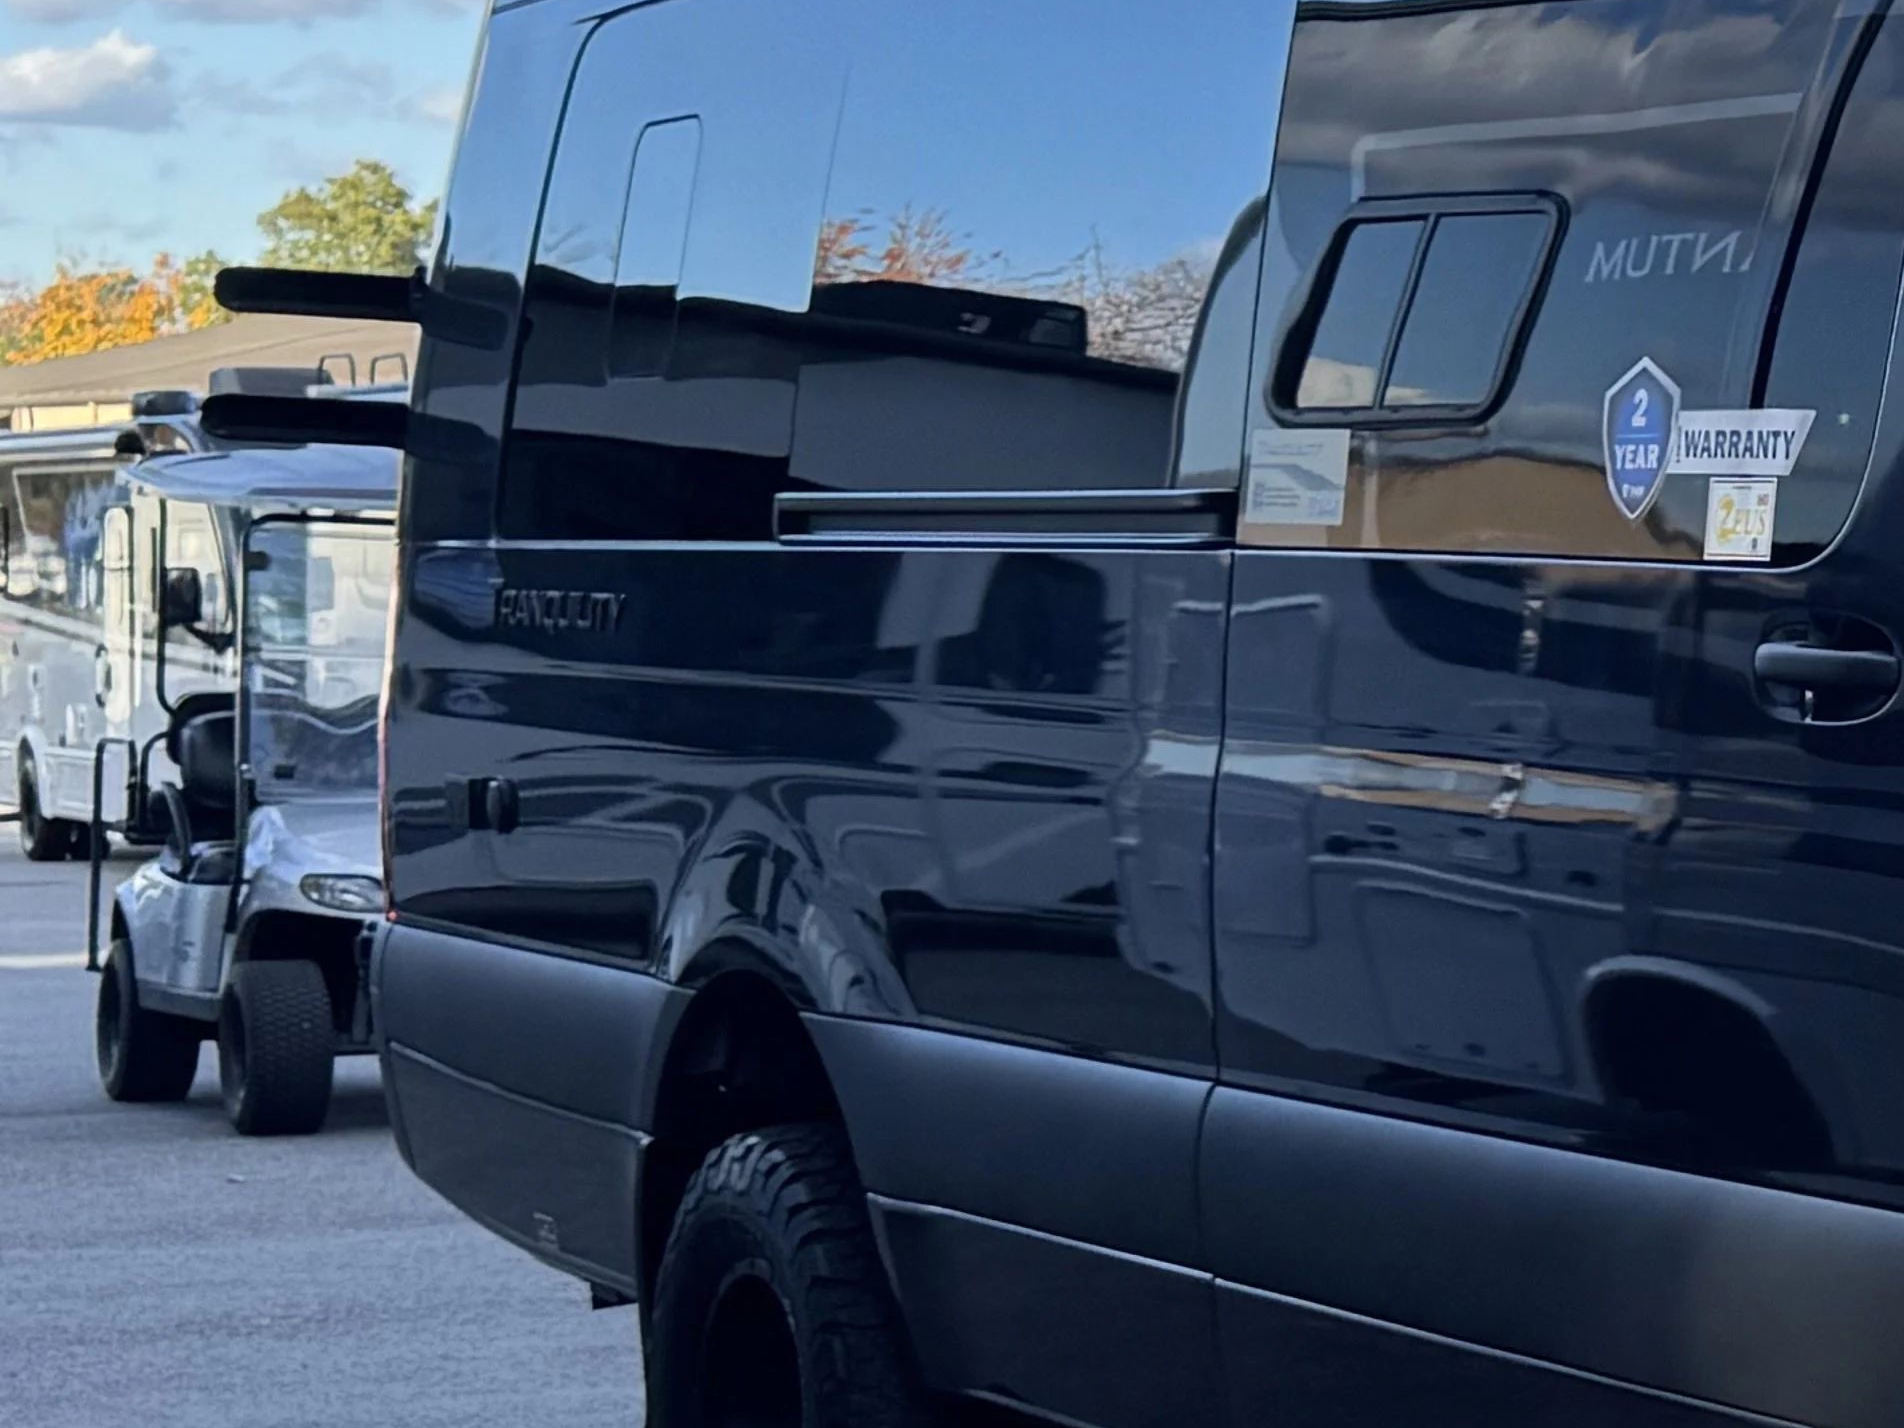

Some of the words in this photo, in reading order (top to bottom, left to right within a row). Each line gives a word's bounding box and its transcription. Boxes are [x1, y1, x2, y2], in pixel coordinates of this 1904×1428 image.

[1631, 388, 1649, 427] 2
[1614, 444, 1659, 471] YEAR
[1684, 429, 1797, 461] WARRANTY
